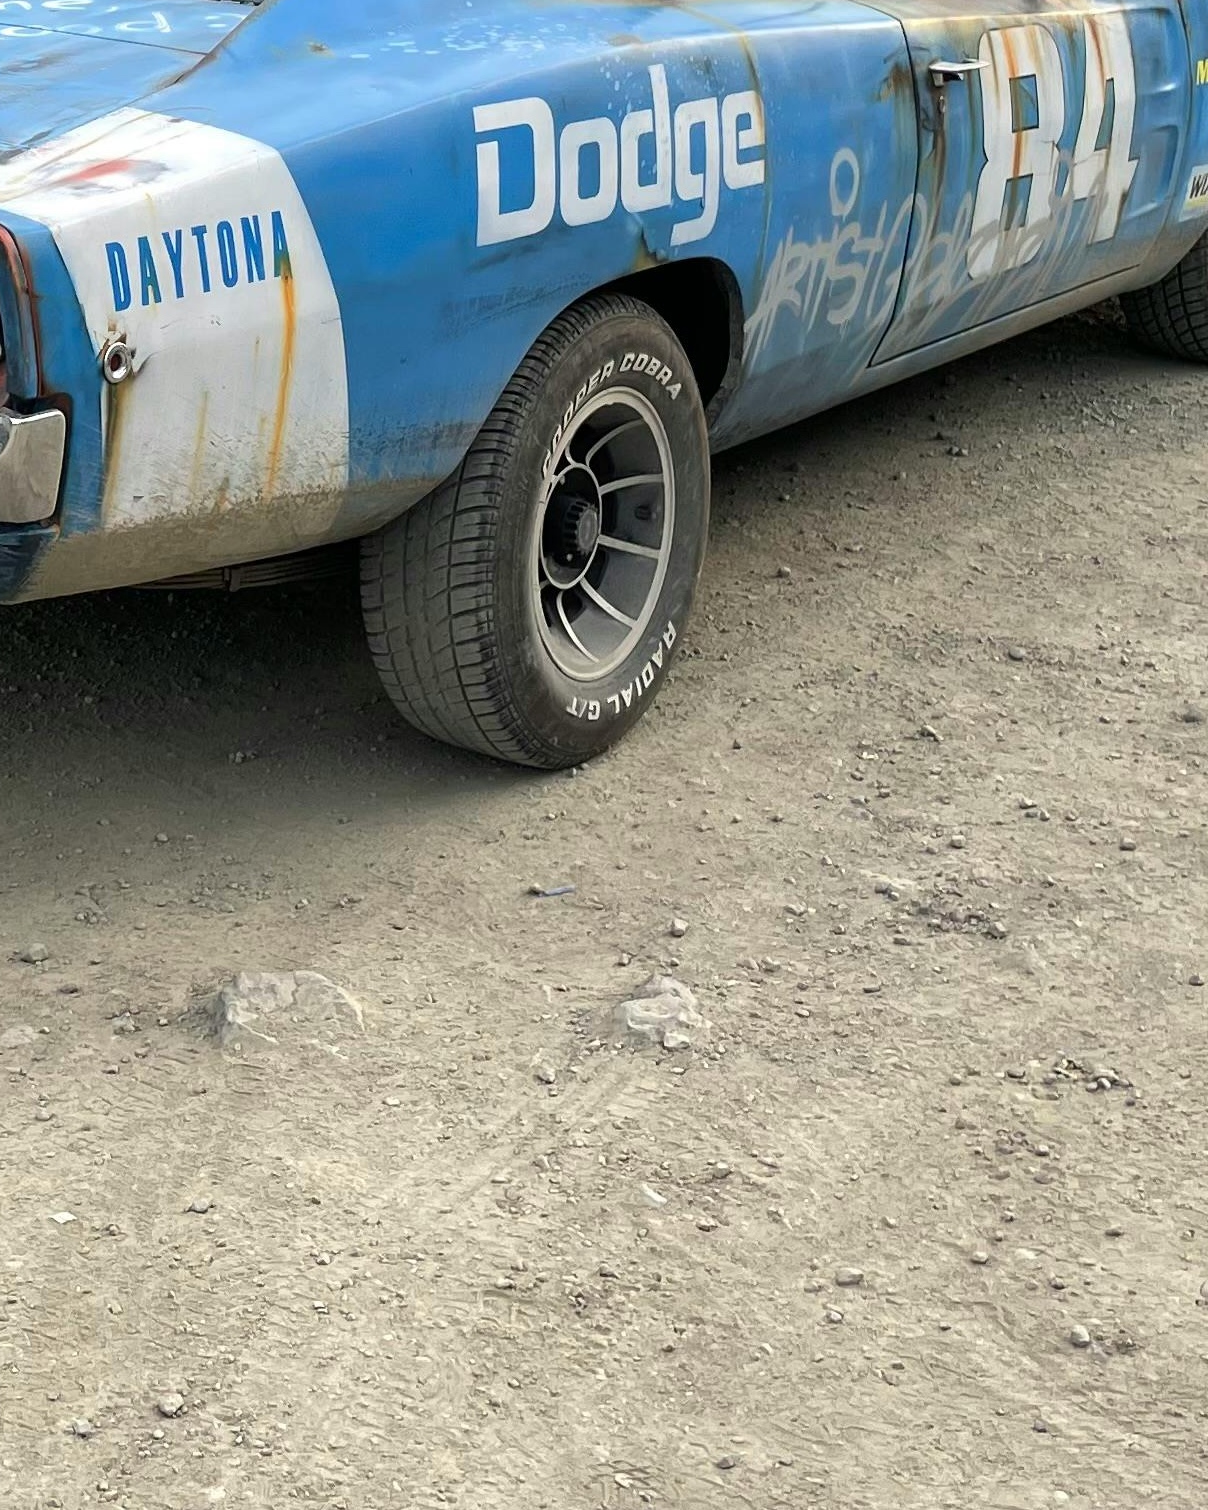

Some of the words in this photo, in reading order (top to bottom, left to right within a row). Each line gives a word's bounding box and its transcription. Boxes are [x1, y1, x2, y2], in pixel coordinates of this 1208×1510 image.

[472, 63, 766, 248] Dodge
[966, 13, 1139, 280] 84
[105, 210, 293, 312] DAYTONA
[620, 352, 682, 401] COBRA
[566, 696, 601, 721] G/T
[606, 620, 677, 714] RADIAL
